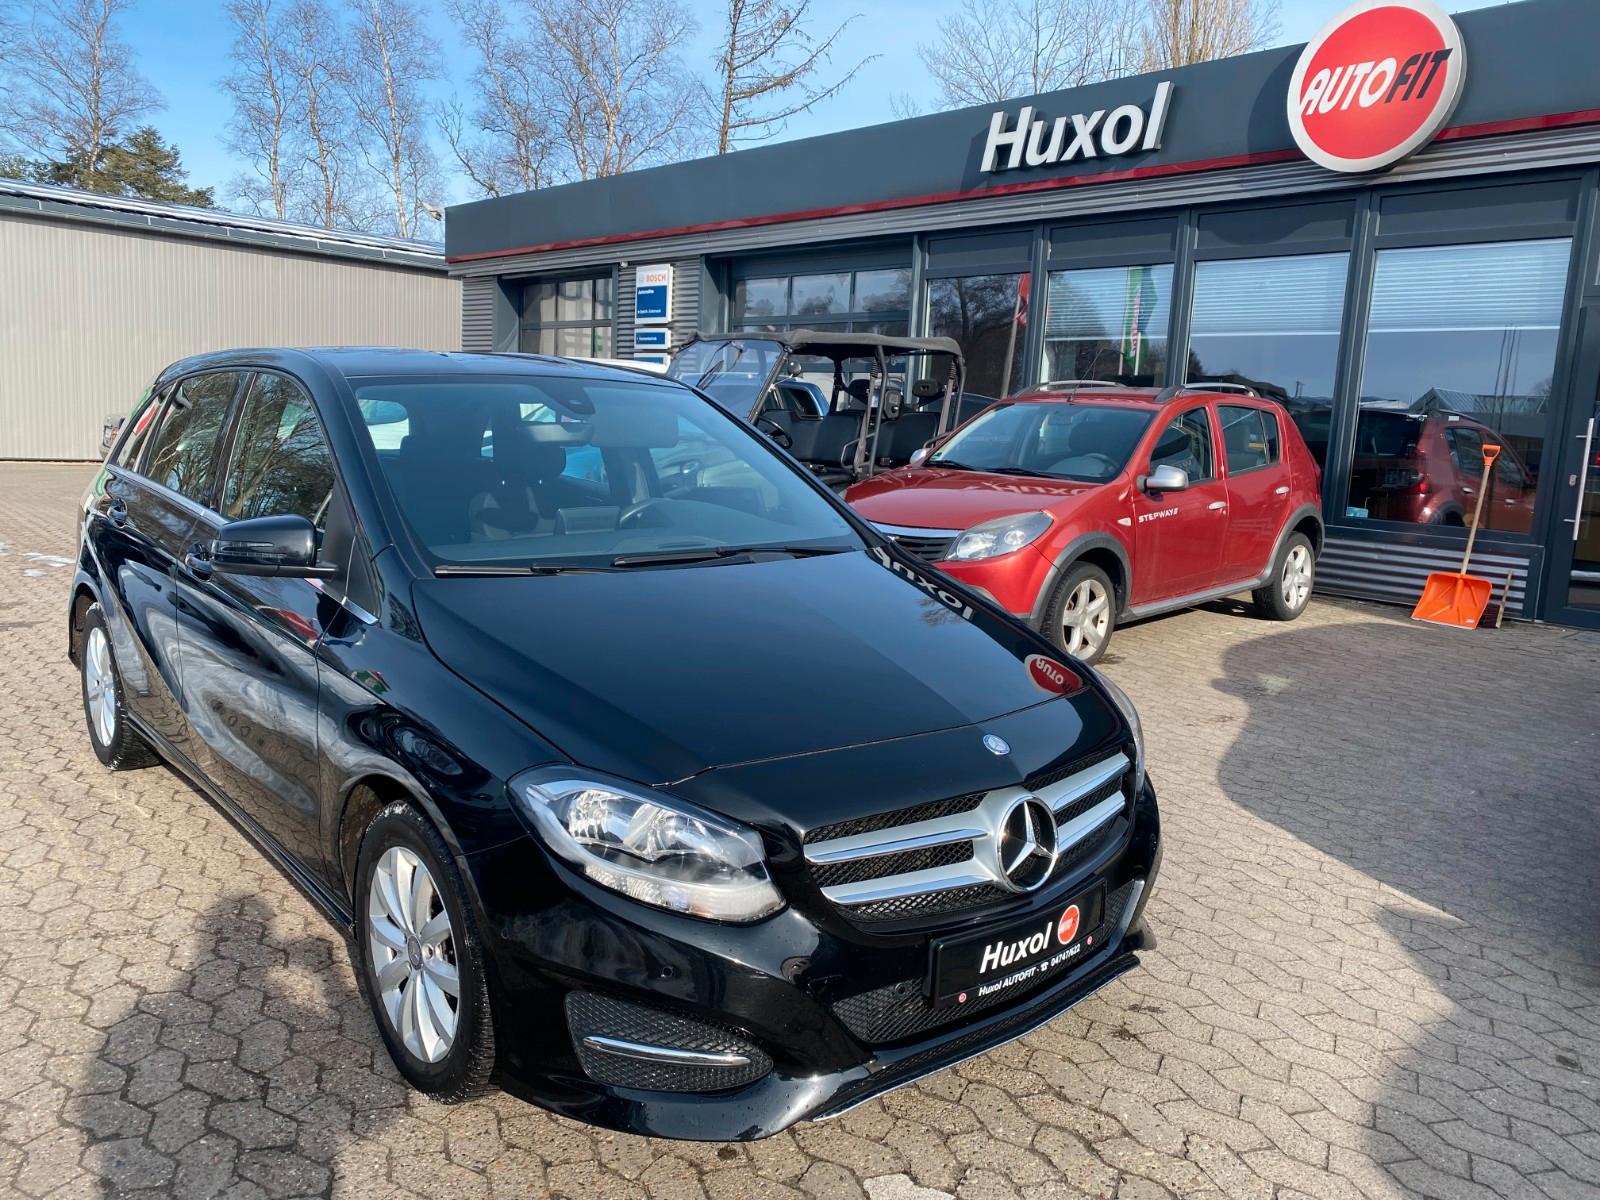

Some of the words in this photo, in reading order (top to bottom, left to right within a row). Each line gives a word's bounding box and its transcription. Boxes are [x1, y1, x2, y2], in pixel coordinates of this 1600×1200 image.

[1300, 48, 1453, 116] AUTOFIT
[980, 80, 1175, 173] Huxol
[646, 273, 666, 282] BOSCH
[979, 921, 1053, 974] Huxol
[978, 980, 1002, 997] Huxol
[1002, 966, 1037, 988] AUTOFIT
